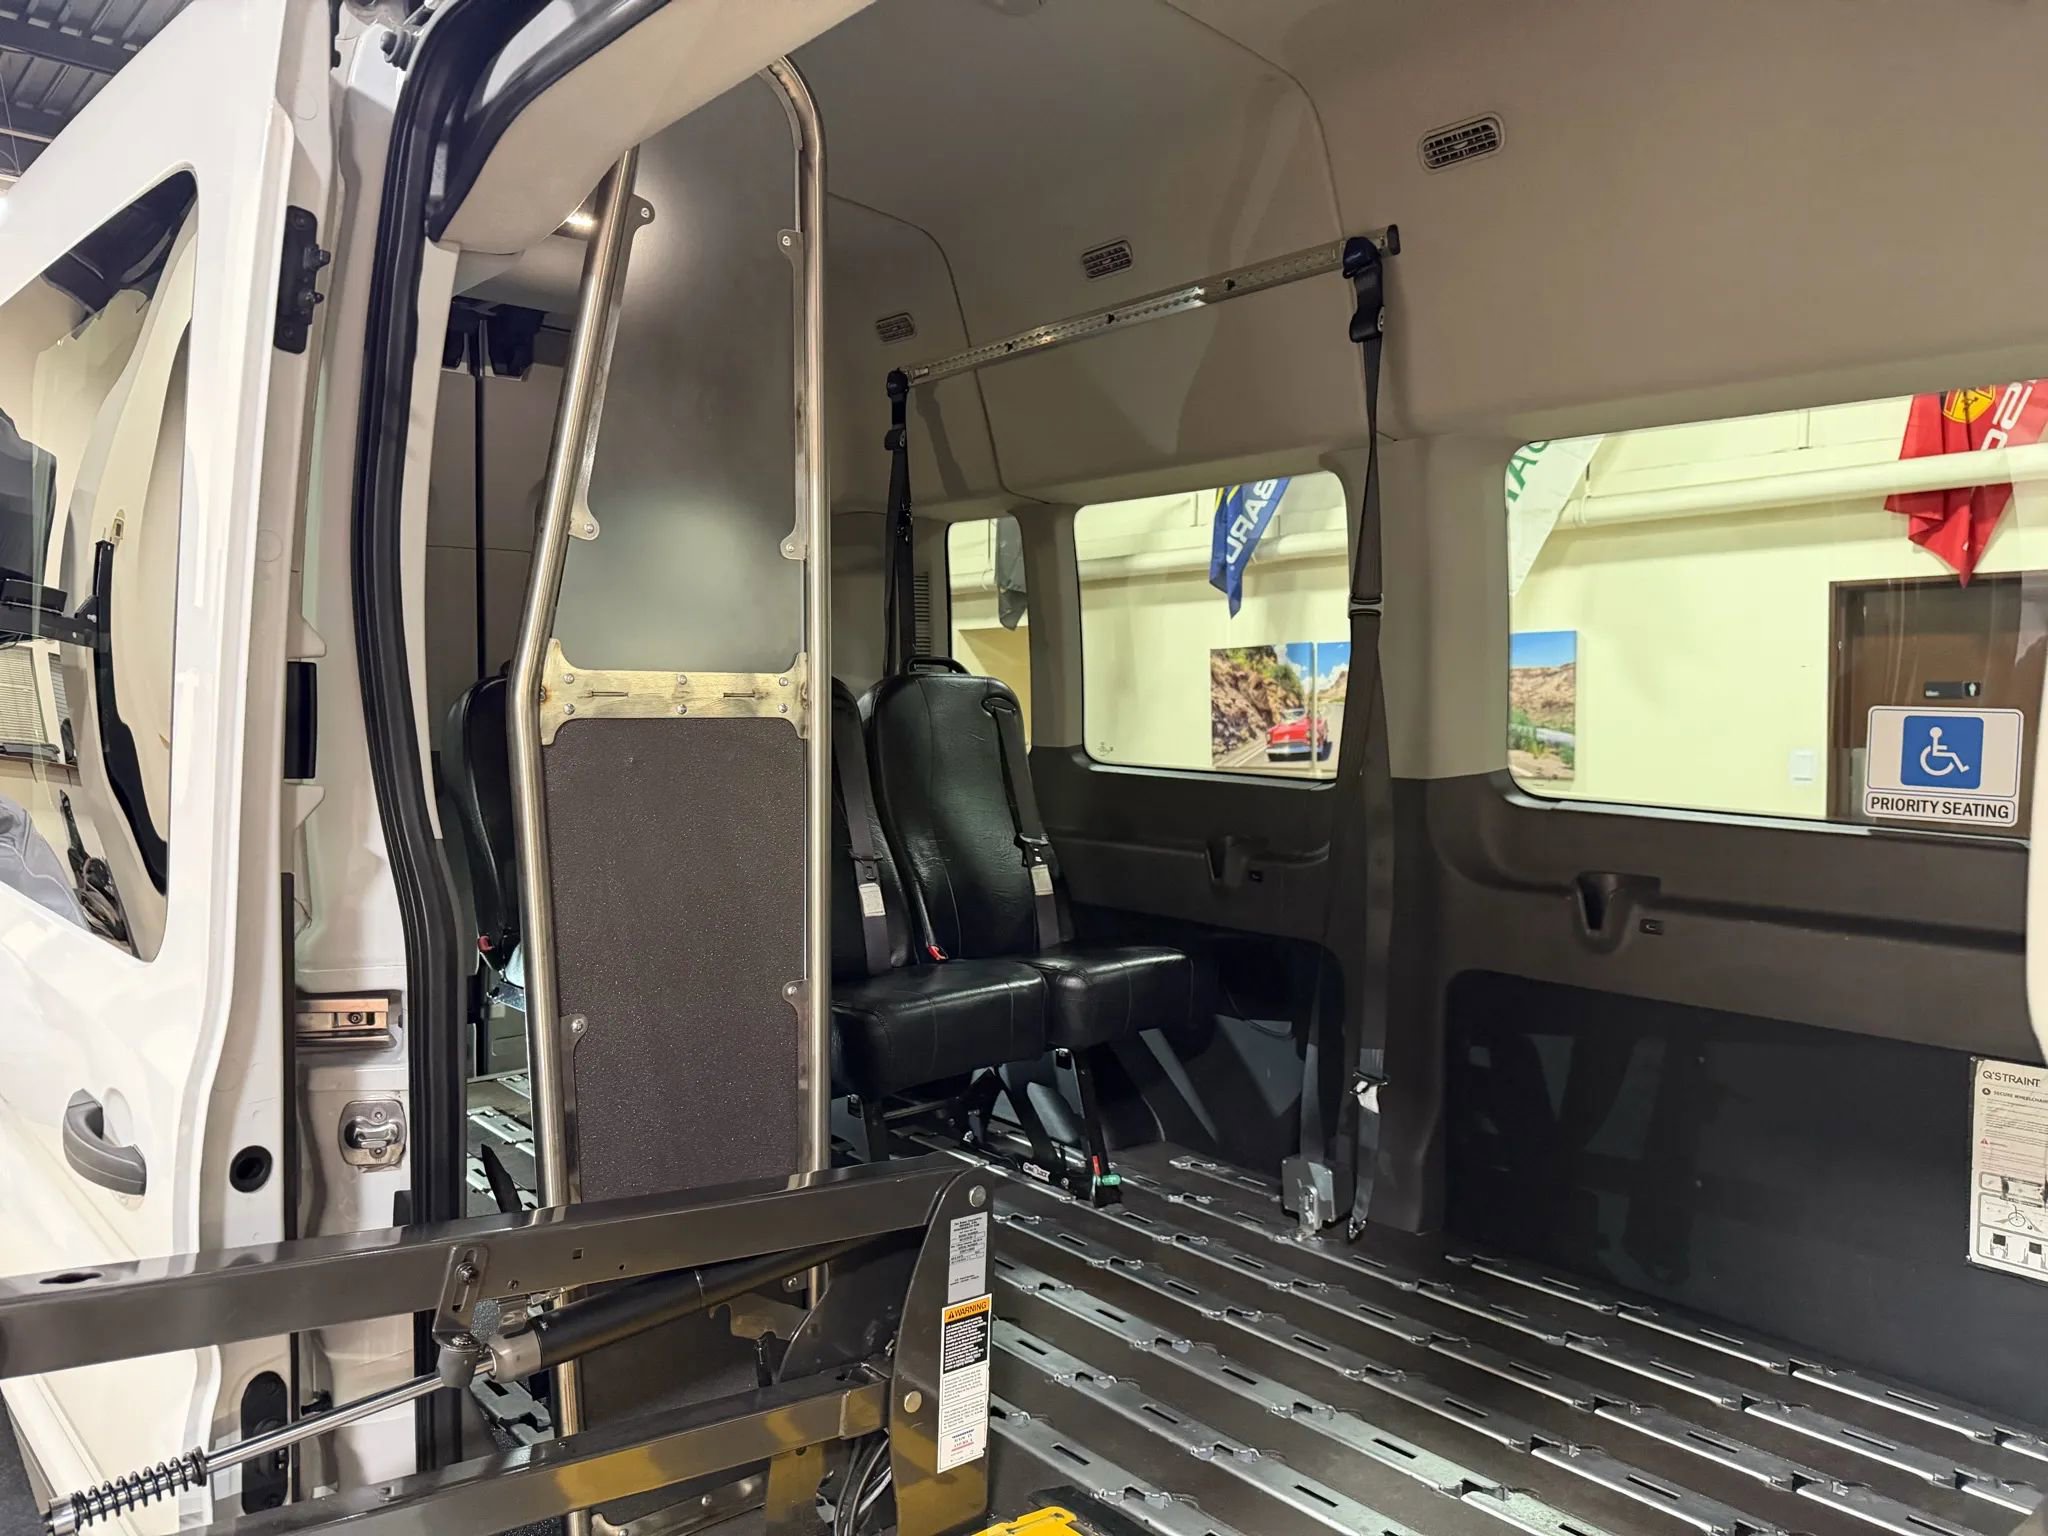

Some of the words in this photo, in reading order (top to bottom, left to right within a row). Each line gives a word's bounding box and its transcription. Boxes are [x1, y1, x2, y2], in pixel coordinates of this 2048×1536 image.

[1871, 796, 1939, 814] PRIORITY
[1942, 801, 2009, 819] SEATING
[1982, 1070, 2041, 1087] Q'STRAINT
[955, 1302, 987, 1316] WARNING
